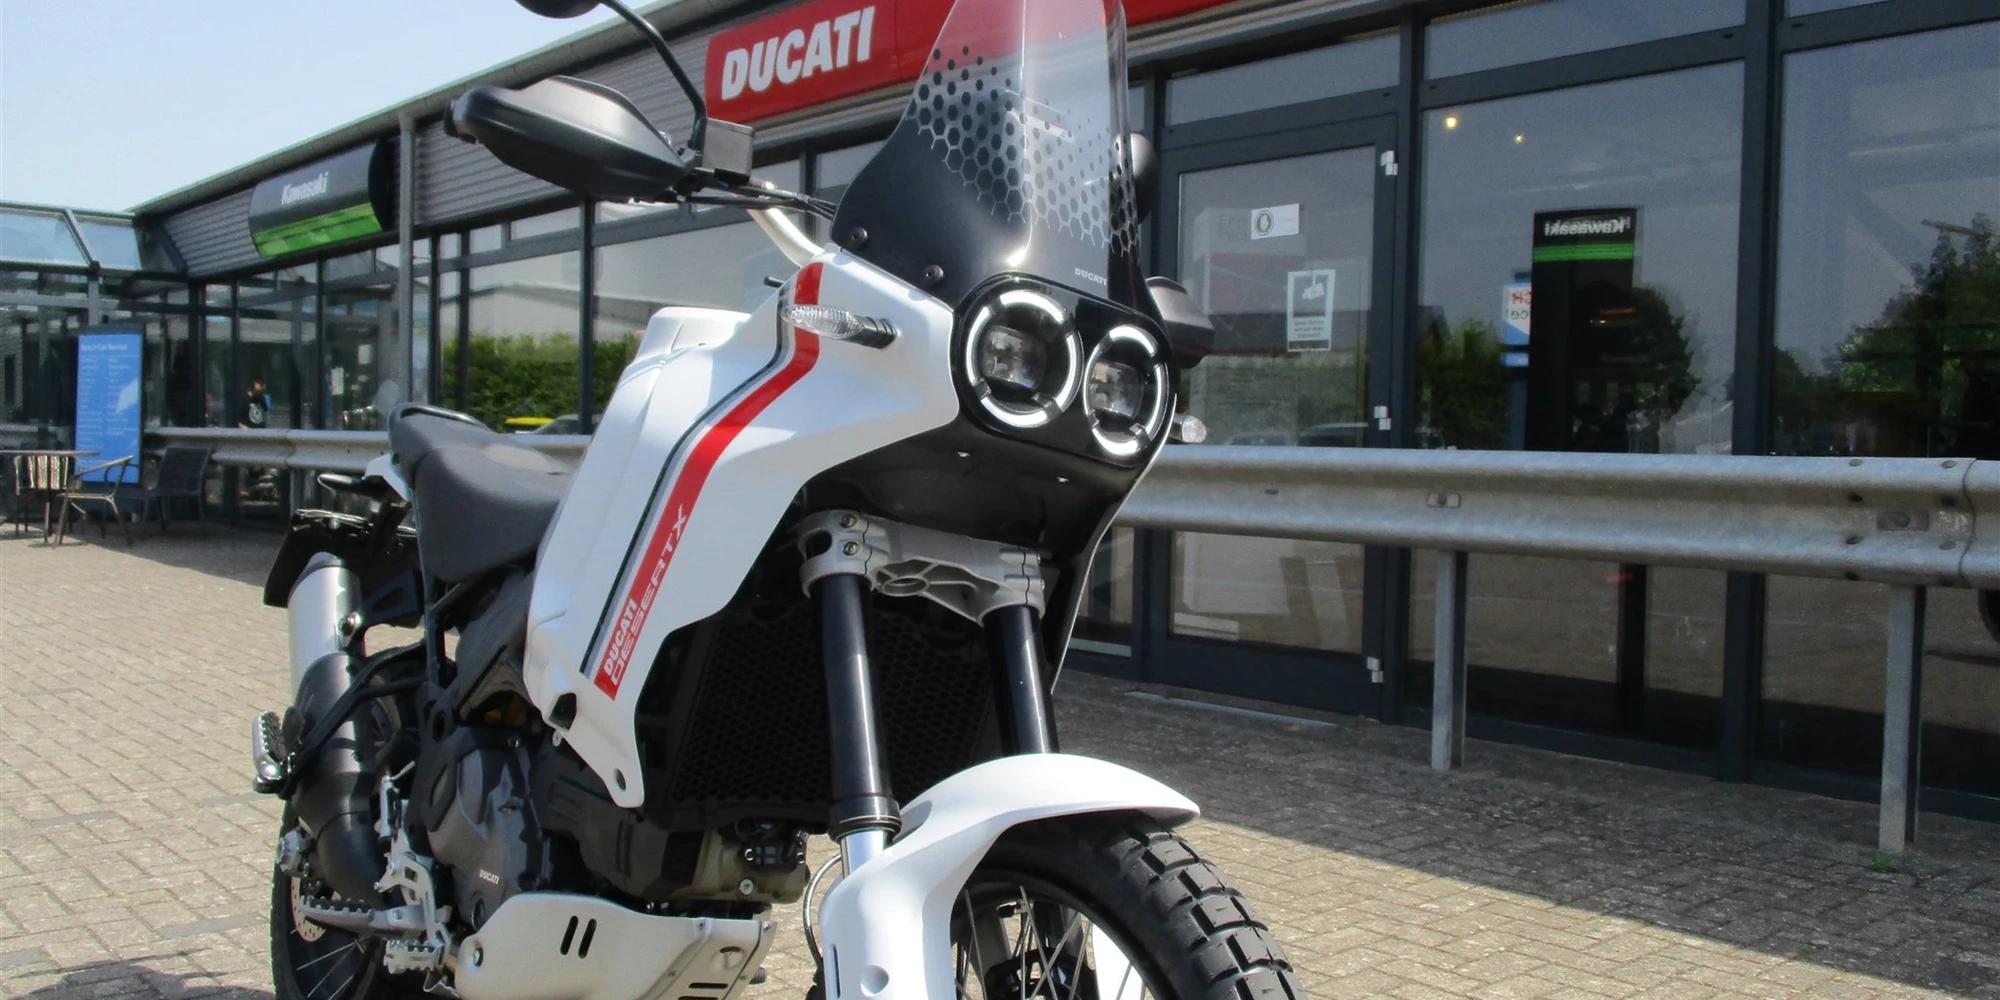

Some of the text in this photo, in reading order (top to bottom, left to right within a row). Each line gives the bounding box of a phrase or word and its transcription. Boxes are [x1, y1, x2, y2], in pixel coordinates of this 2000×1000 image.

[721, 5, 875, 101] DUCATI
[281, 171, 329, 205] Kawasaki
[1074, 267, 1108, 286] DUCATI
[610, 503, 688, 686] DESERTX
[603, 597, 637, 675] DUCATI
[479, 869, 500, 885] DUCATI
